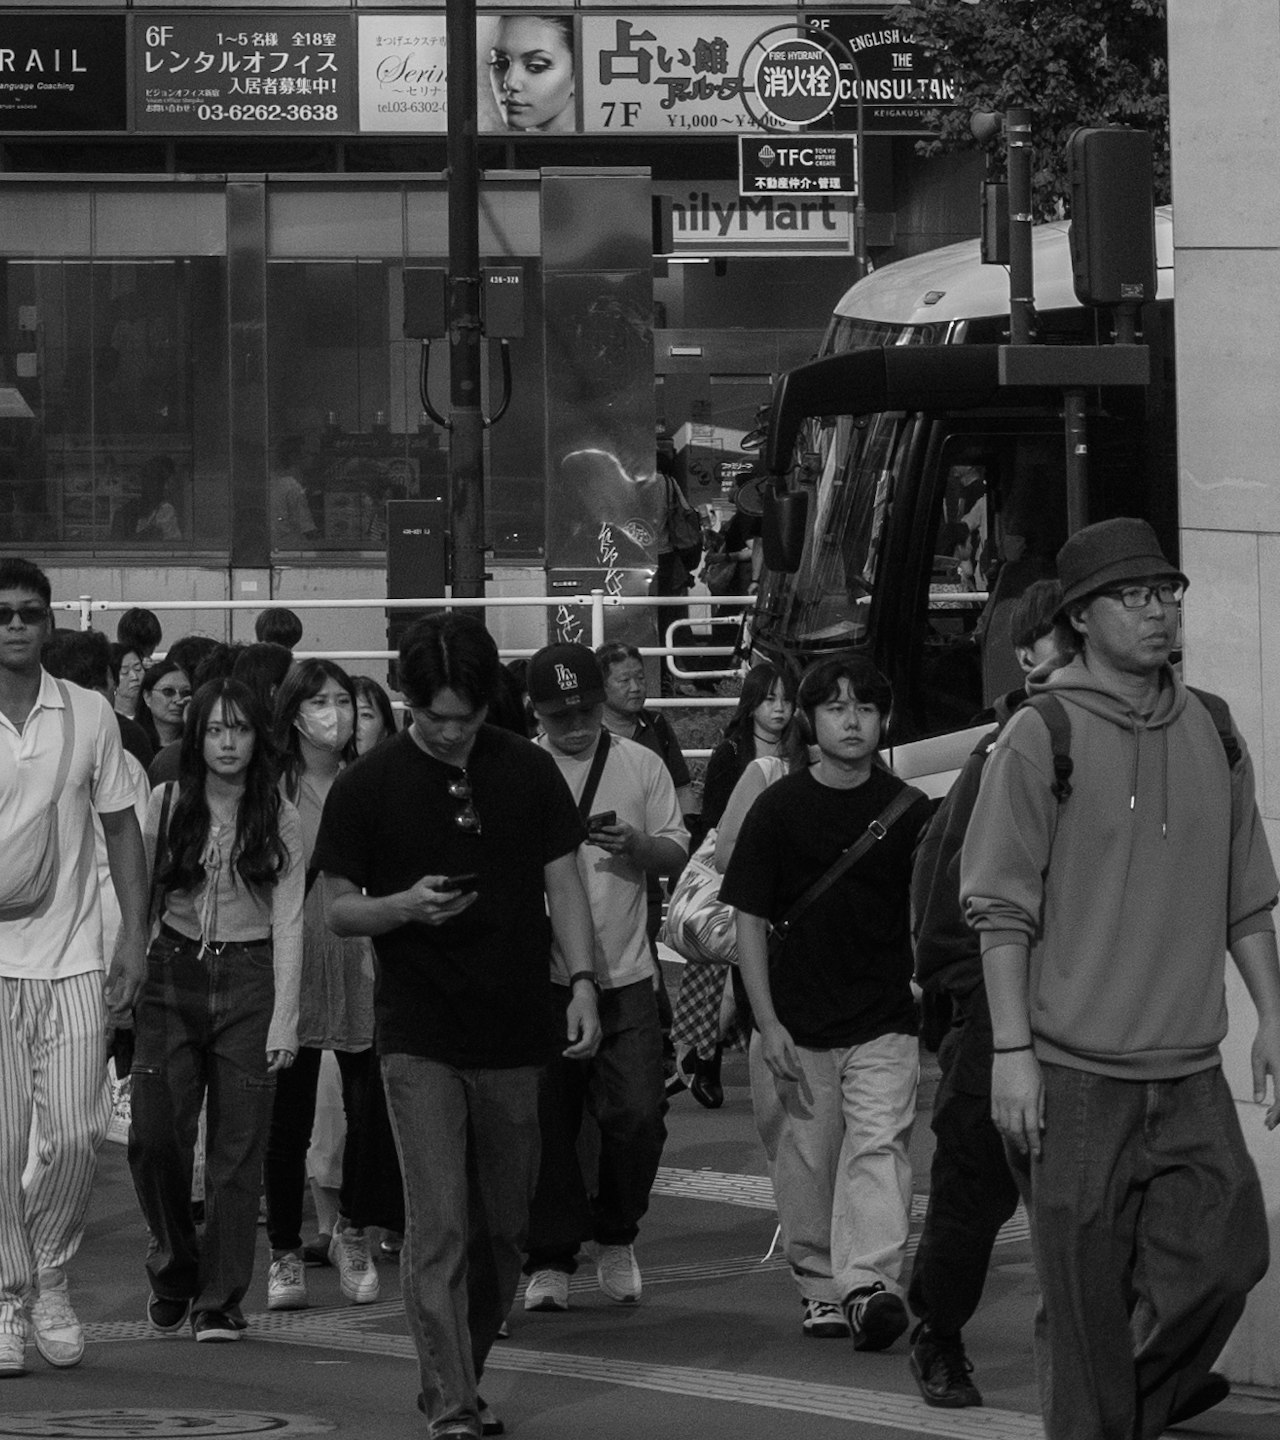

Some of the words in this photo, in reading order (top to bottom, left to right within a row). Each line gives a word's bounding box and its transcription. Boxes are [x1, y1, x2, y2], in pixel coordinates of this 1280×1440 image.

[145, 25, 174, 47] 6F
[291, 31, 338, 47] 全18室
[848, 29, 900, 53] ENGLISH
[599, 19, 729, 85] 占い館
[768, 51, 786, 60] FIRE
[787, 51, 823, 61] HYDRANT
[891, 52, 913, 68] THE
[145, 50, 339, 75] レンタルオフィス
[36, 81, 76, 92] Coaching
[763, 64, 832, 98] 消火栓
[197, 104, 339, 121] 03-6262-3638
[600, 101, 642, 128] 7F
[776, 148, 814, 167] TFC
[754, 176, 841, 190] 不動産仲介・管理
